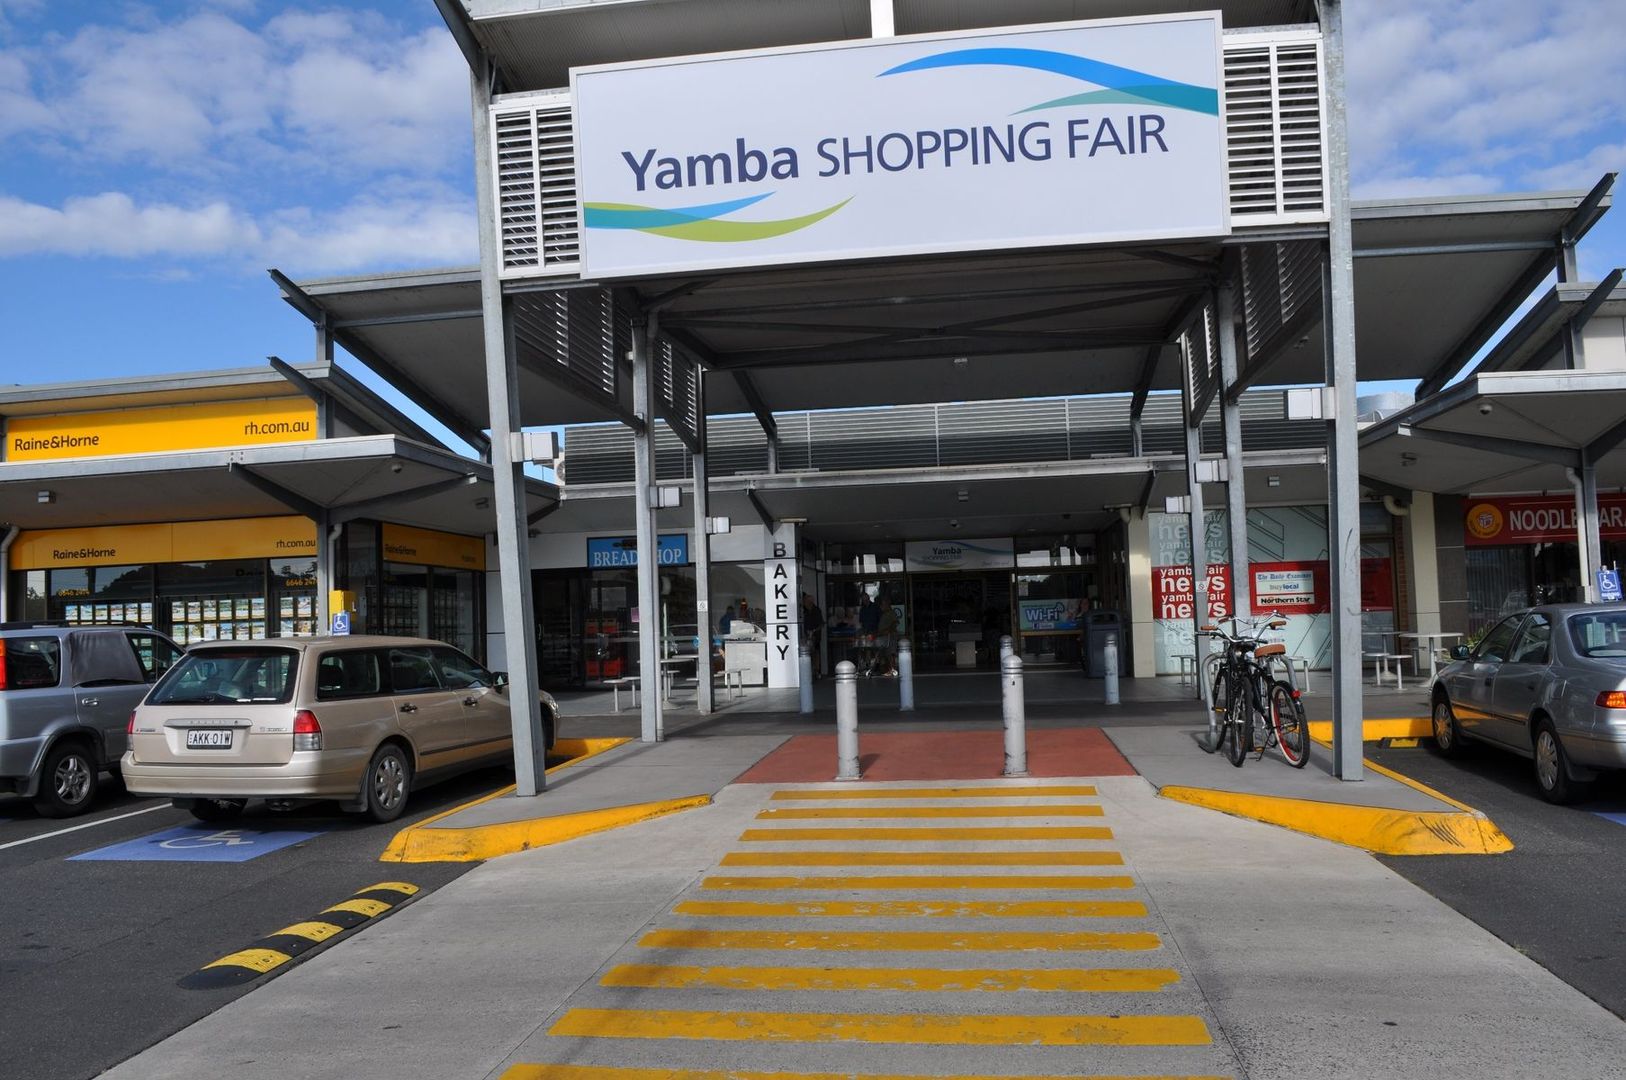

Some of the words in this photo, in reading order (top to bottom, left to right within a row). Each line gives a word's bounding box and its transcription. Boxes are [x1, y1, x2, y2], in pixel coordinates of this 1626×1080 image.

[622, 138, 800, 191] Yamba
[817, 121, 1052, 177] SHOPPING
[1068, 114, 1169, 159] FAIR
[244, 420, 310, 435] rh.com.au
[14, 435, 100, 451] Raine&Horne
[1599, 507, 1626, 528] AR
[1159, 523, 1223, 539] nes
[276, 539, 316, 548] rh.com.au
[53, 547, 116, 559] Raine&Horne
[593, 550, 638, 567] BREAD
[656, 548, 682, 565] HOP
[1160, 549, 1224, 565] nes
[1160, 566, 1192, 578] yamb
[773, 542, 789, 660] BAKERY
[1161, 592, 1193, 604] yamb
